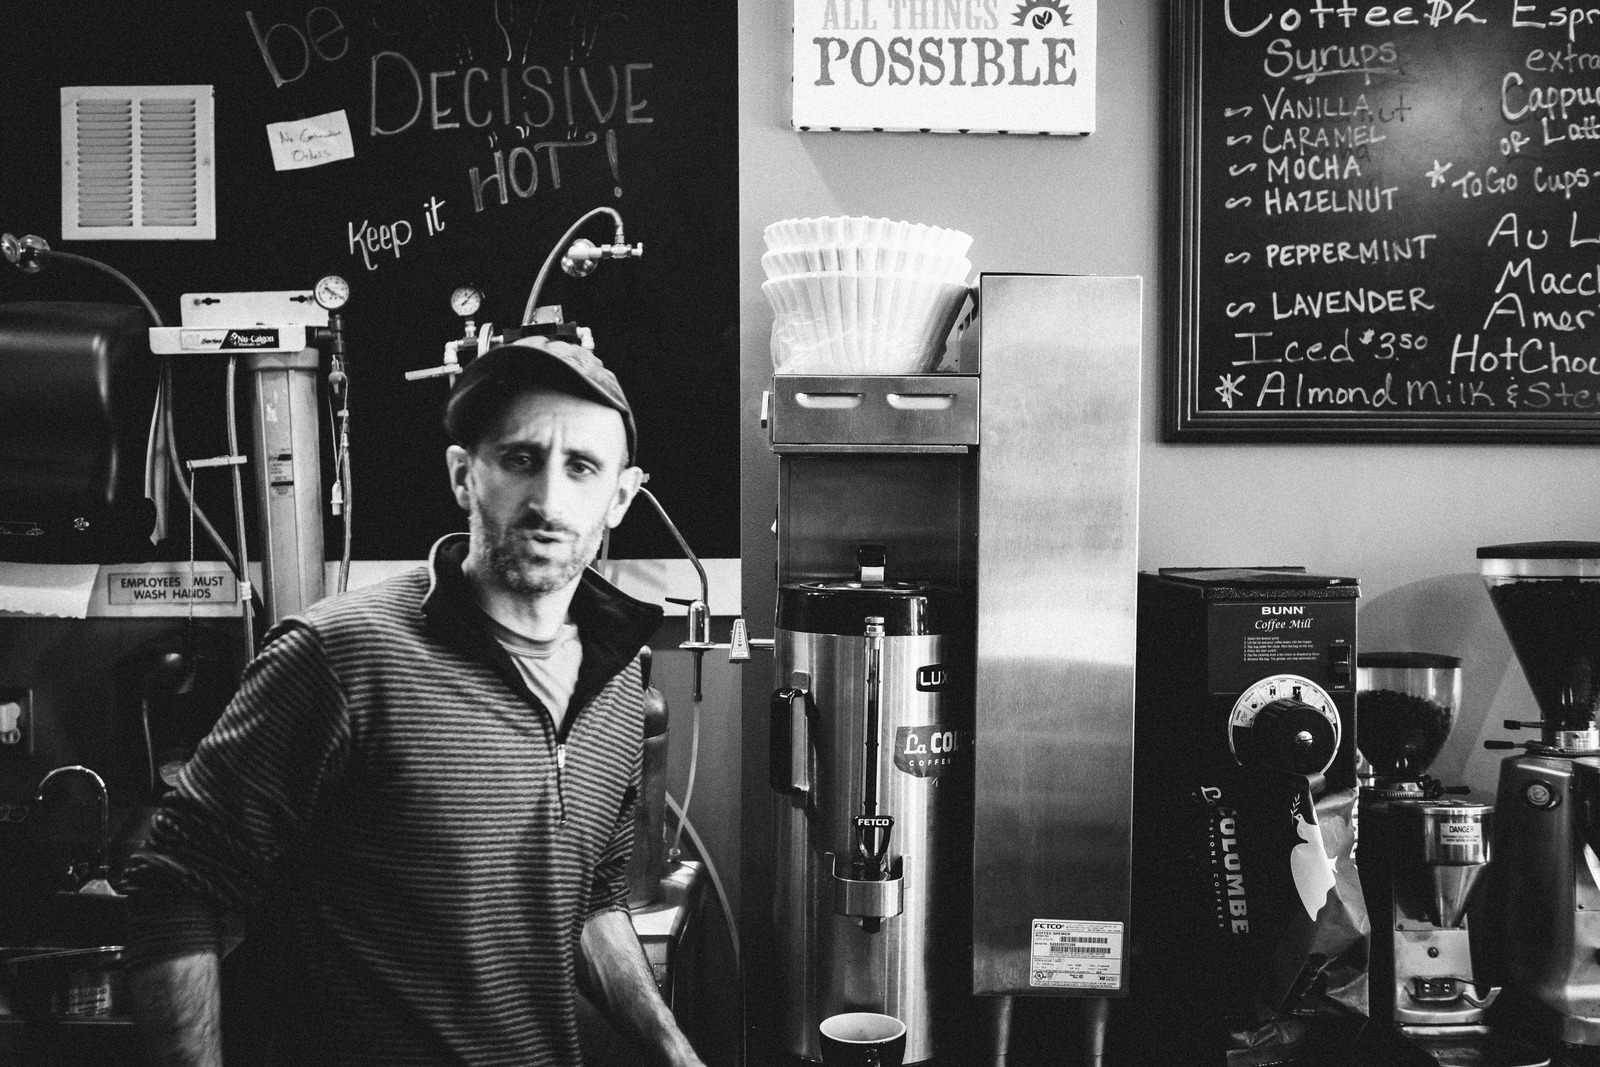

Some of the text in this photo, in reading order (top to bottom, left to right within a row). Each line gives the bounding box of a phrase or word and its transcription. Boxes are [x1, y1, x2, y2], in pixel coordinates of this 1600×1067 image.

[821, 0, 999, 30] ALL THINGS
[1224, 0, 1419, 38] Coffee
[245, 6, 349, 88] be
[812, 36, 1077, 88] POSSIBLE
[1263, 38, 1398, 85] Syrups
[370, 50, 654, 137] DECISIVE
[1262, 87, 1374, 121] VANILLA
[1262, 124, 1387, 156] CARAMEL
[1268, 154, 1361, 184] MOCHA
[1264, 186, 1400, 216] HAZELNUT
[348, 219, 412, 270] Keep
[423, 196, 446, 236] it
[1265, 234, 1437, 268] PEPPERMINT
[1494, 257, 1600, 297] Macc
[1273, 287, 1435, 320] LAVENDER
[1231, 327, 1355, 367] Iced
[1256, 371, 1398, 408] Almond
[121, 576, 224, 588] EMPLOYEES MUST
[134, 588, 211, 600] WASH HANDS
[1254, 618, 1314, 632] Coffee Mill
[1261, 606, 1304, 615] BUNN
[903, 733, 928, 755] La
[857, 818, 890, 827] FETCO
[1449, 825, 1474, 833] DANGER
